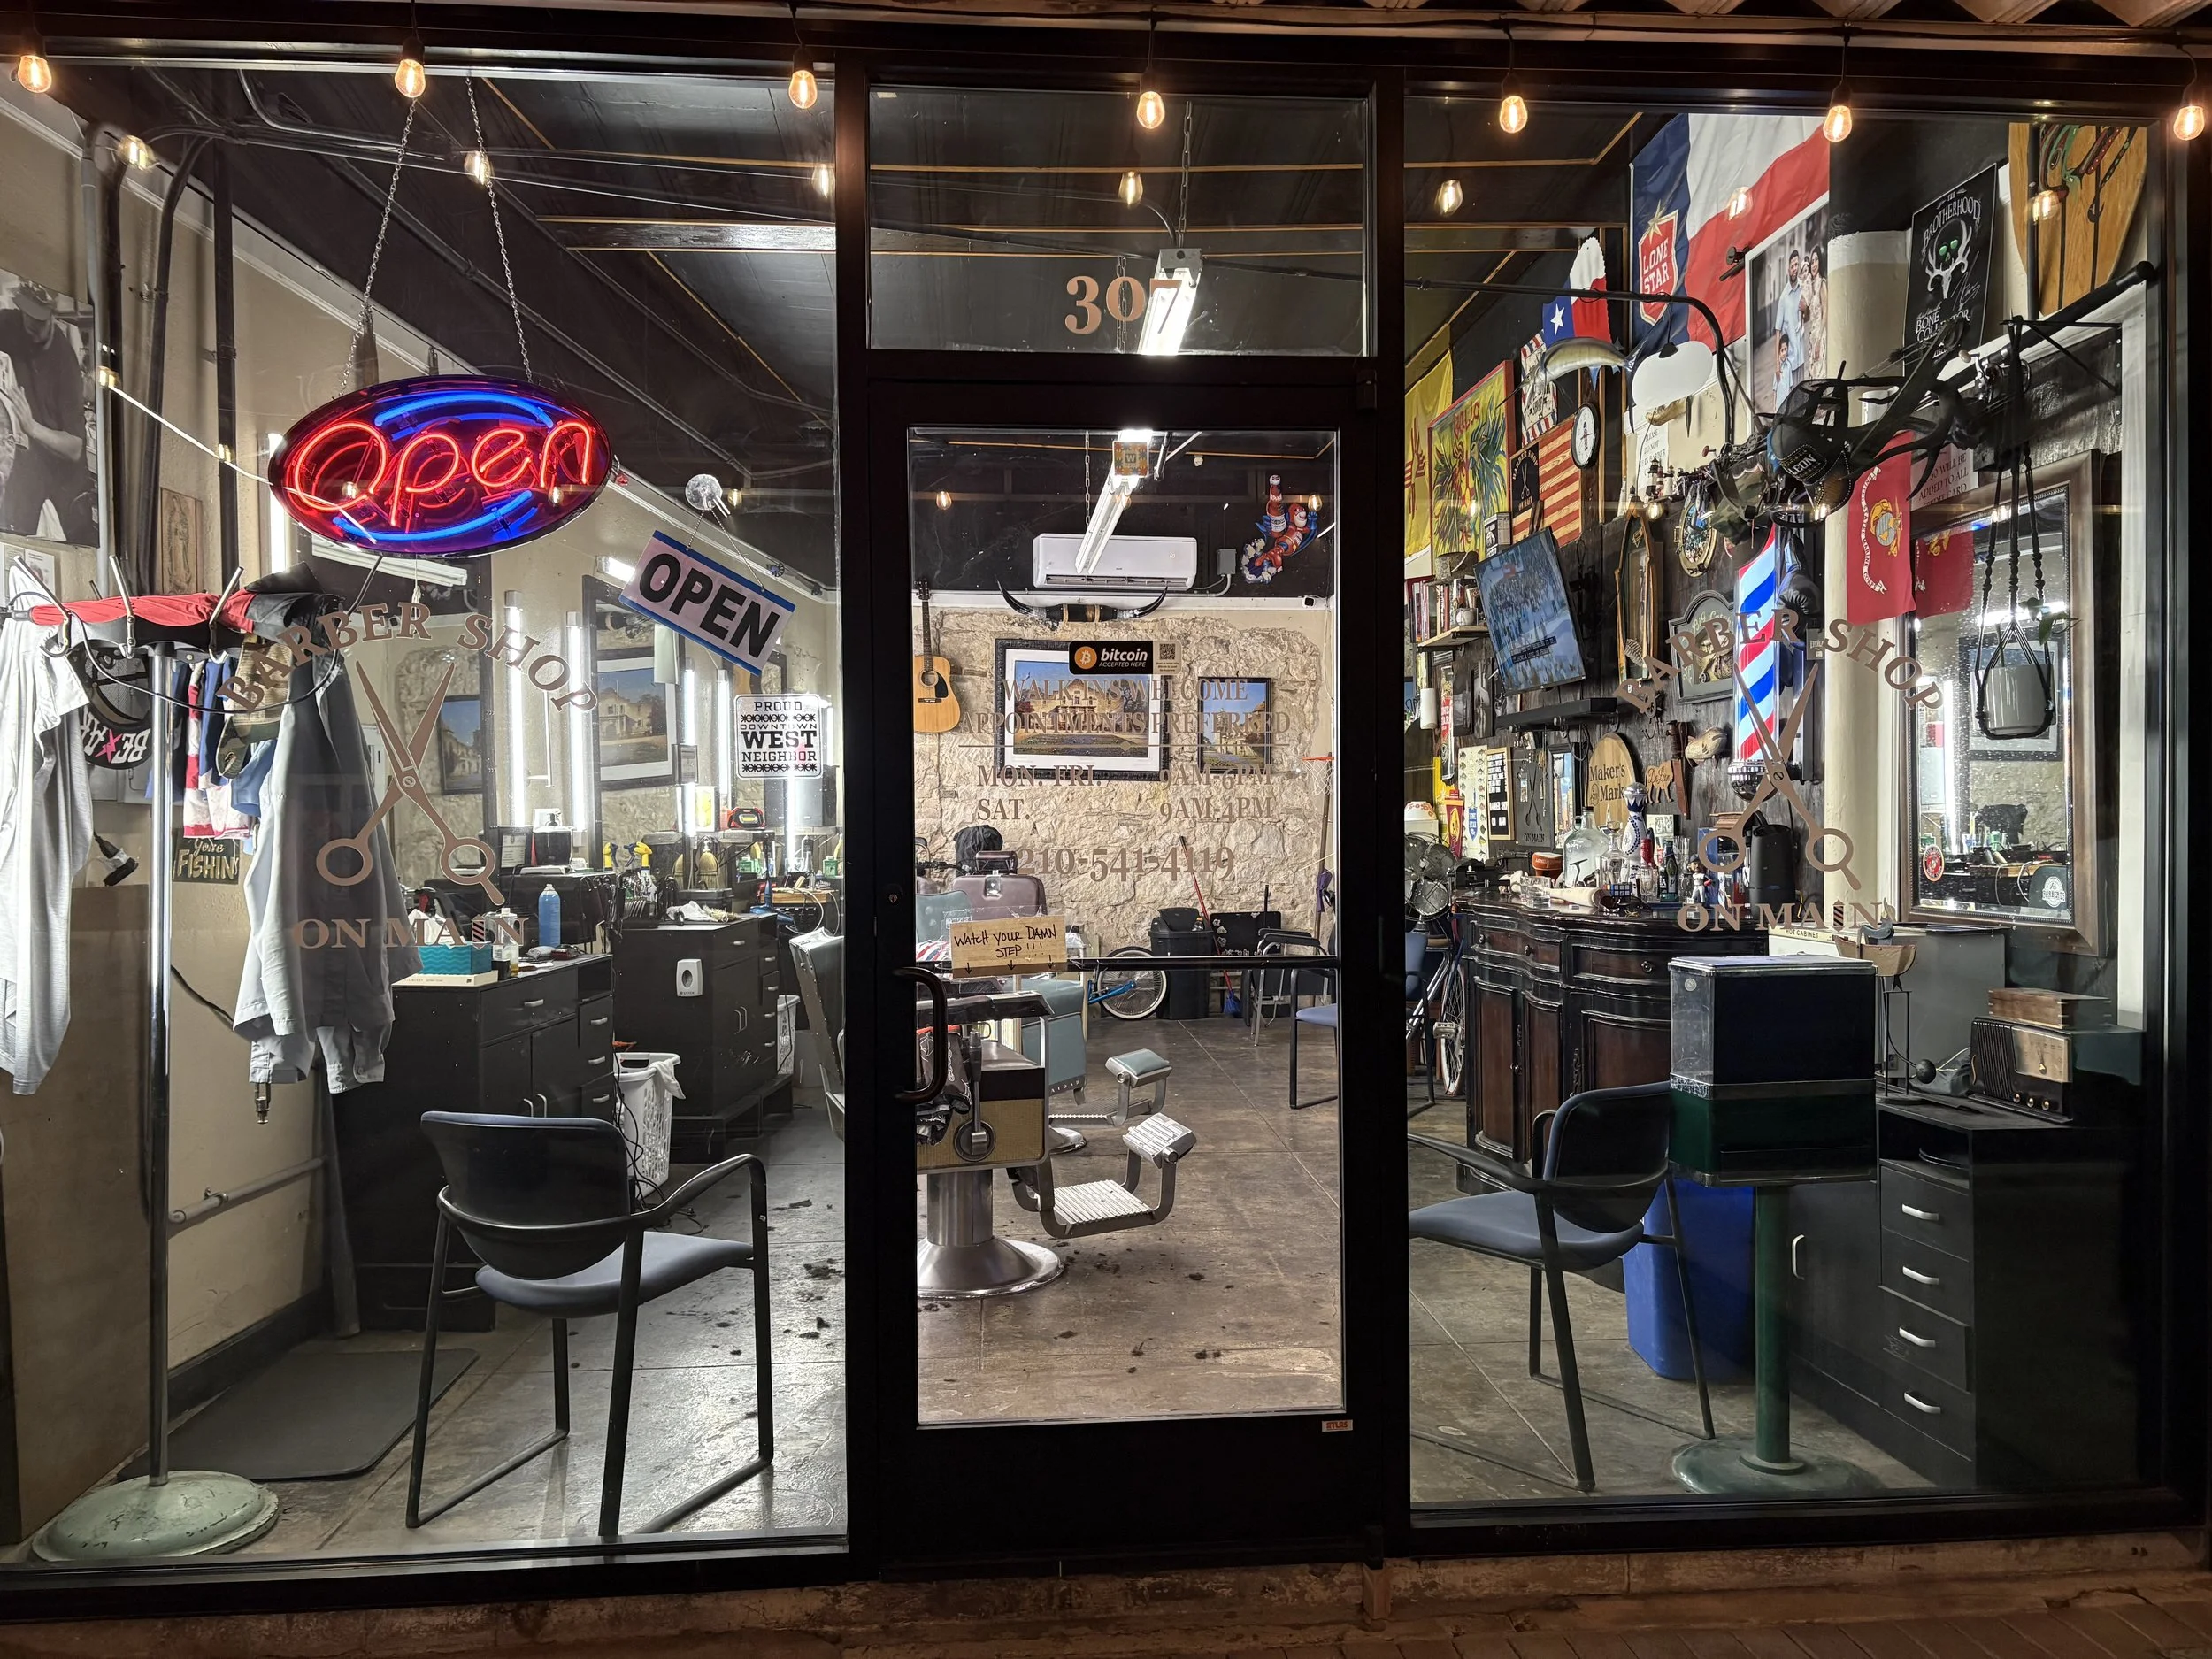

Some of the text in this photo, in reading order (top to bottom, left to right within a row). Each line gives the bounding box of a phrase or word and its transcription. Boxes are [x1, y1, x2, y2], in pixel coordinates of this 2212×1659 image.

[1923, 196, 1982, 248] BROTHERHOOD
[1642, 237, 1669, 275] LONE
[1643, 261, 1671, 295] STAR
[1064, 275, 1183, 334] 307
[1915, 311, 1940, 334] BONE
[1916, 309, 1971, 343] COLLTOR
[293, 420, 594, 527] Open
[1787, 453, 1817, 475] LEON
[1939, 458, 1956, 476] WILL
[1957, 451, 1968, 465] BE
[1955, 466, 1970, 482] ALL
[638, 552, 782, 660] OPEN
[216, 602, 599, 714] BARBER SHOP
[1100, 648, 1148, 662] bitcoin
[1613, 607, 1944, 714] BARBER SHOP
[1002, 678, 1248, 701] WALK INS WELCOME
[754, 701, 803, 712] PROUD
[958, 711, 1291, 734] APPOINTMENTS PREFERRED
[741, 730, 818, 749] WEST
[741, 750, 818, 762] NEIGHBOR
[977, 764, 1272, 790] MON. FRI. 9AM-6PM
[1589, 763, 1626, 782] Maker's
[1600, 783, 1625, 802] Mark
[977, 797, 1272, 824] SAT. 9AM-4PM
[1017, 847, 1236, 882] 210-541-4119
[1677, 900, 1884, 932] ON MAIN
[293, 914, 528, 949] ON MAIN
[993, 931, 1024, 947] YOUR
[1025, 924, 1057, 940] DAMN
[1796, 929, 1819, 939] CABINET
[995, 945, 1023, 958] STEP
